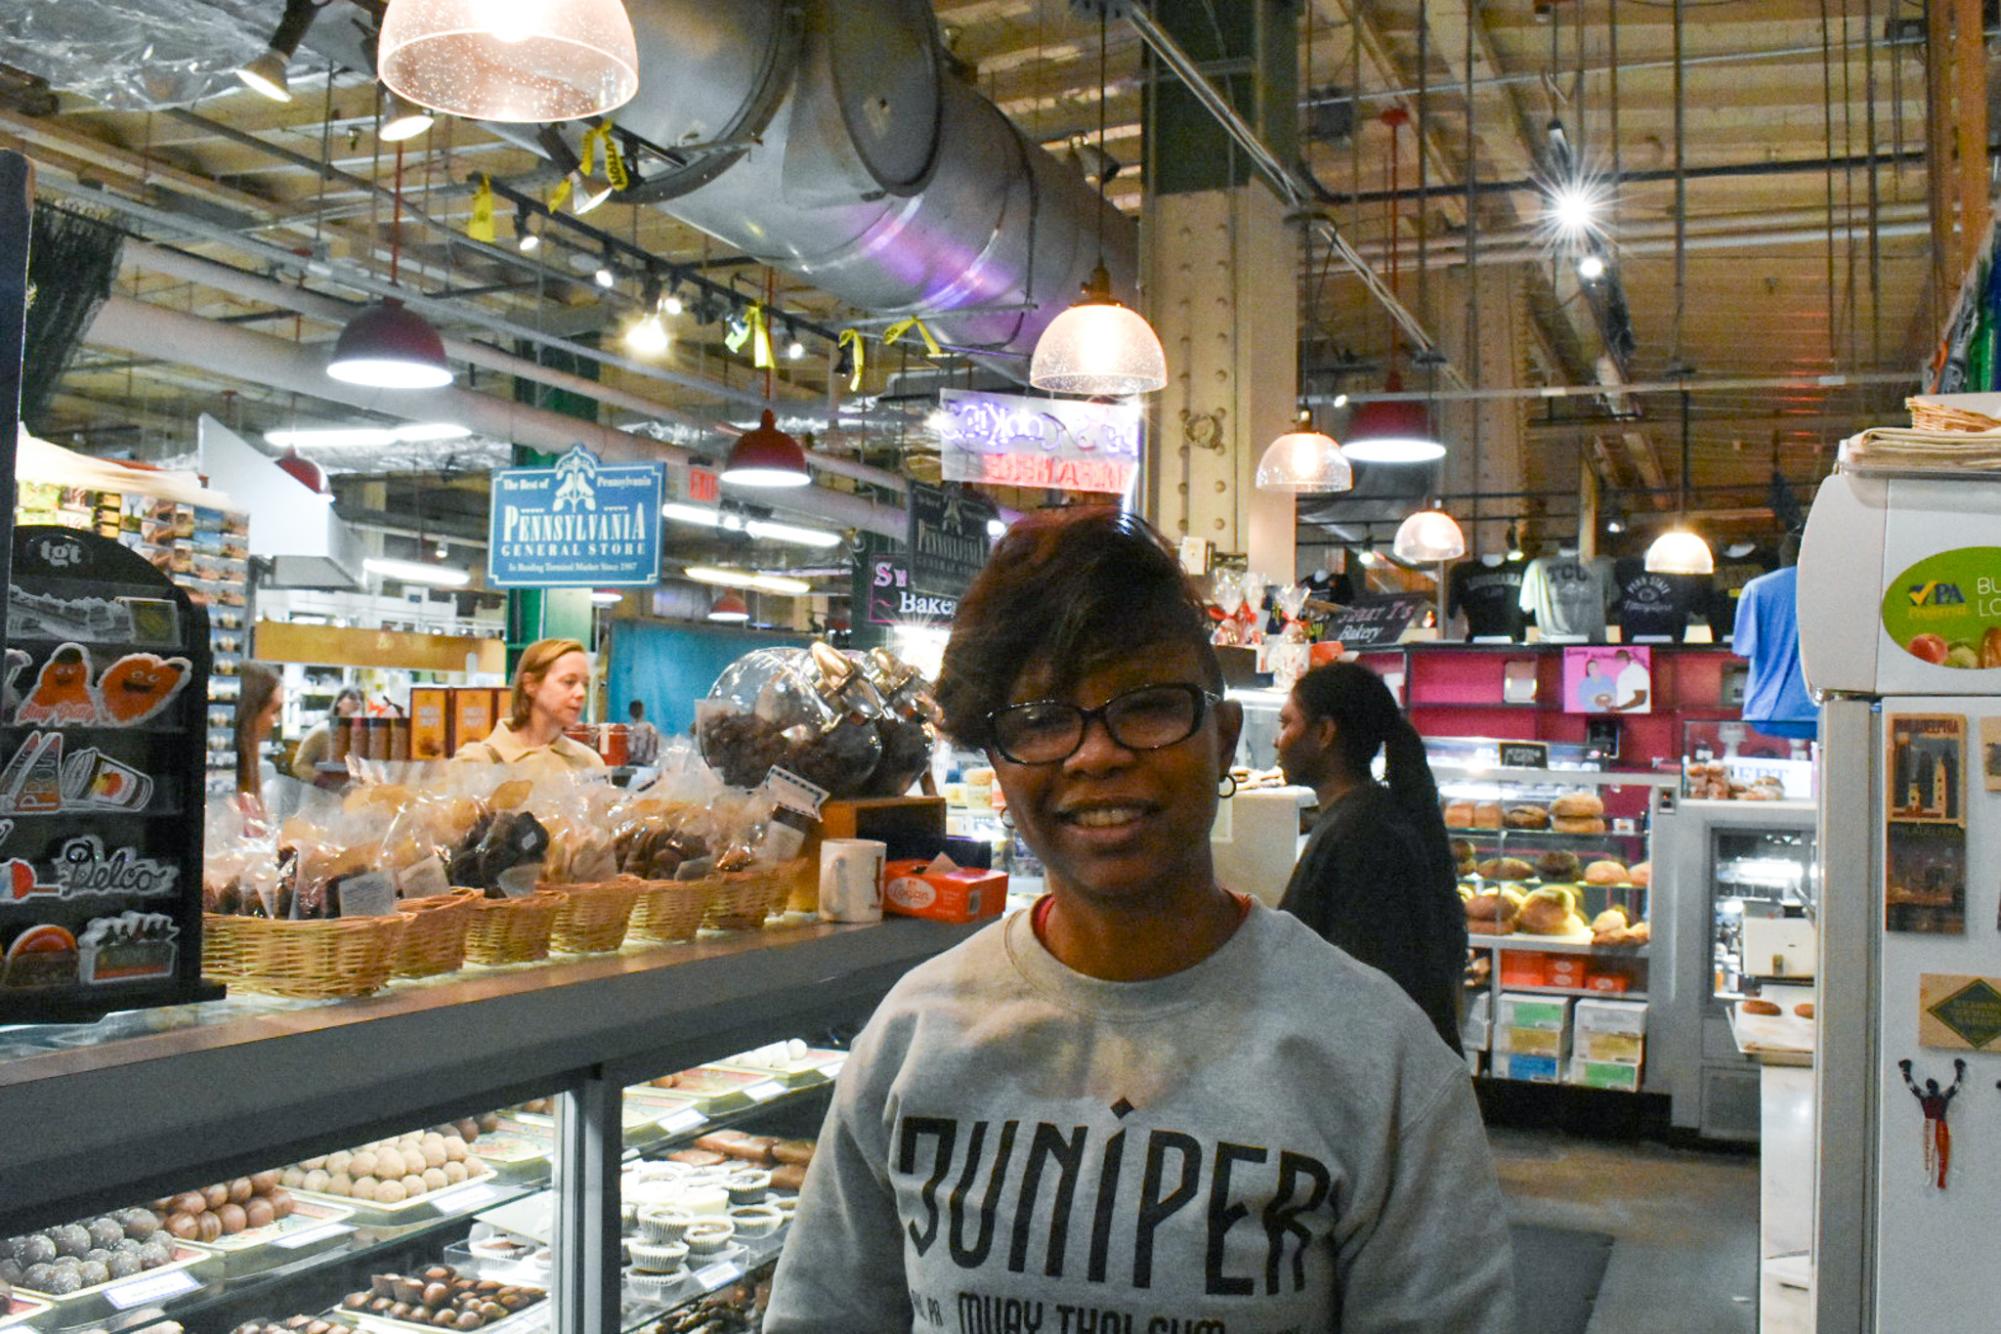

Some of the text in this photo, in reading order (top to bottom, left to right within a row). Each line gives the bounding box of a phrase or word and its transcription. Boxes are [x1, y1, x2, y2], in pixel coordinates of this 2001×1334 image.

[504, 479, 518, 490] The
[520, 478, 537, 490] Best
[539, 478, 550, 490] of
[503, 502, 646, 542] PENNSYLVANIA
[501, 543, 646, 557] GENERAL STORE
[1935, 582, 1965, 605] PA
[1337, 624, 1384, 643] Bakery
[61, 840, 168, 897] Delco
[900, 1097, 1330, 1296] JUNIPER
